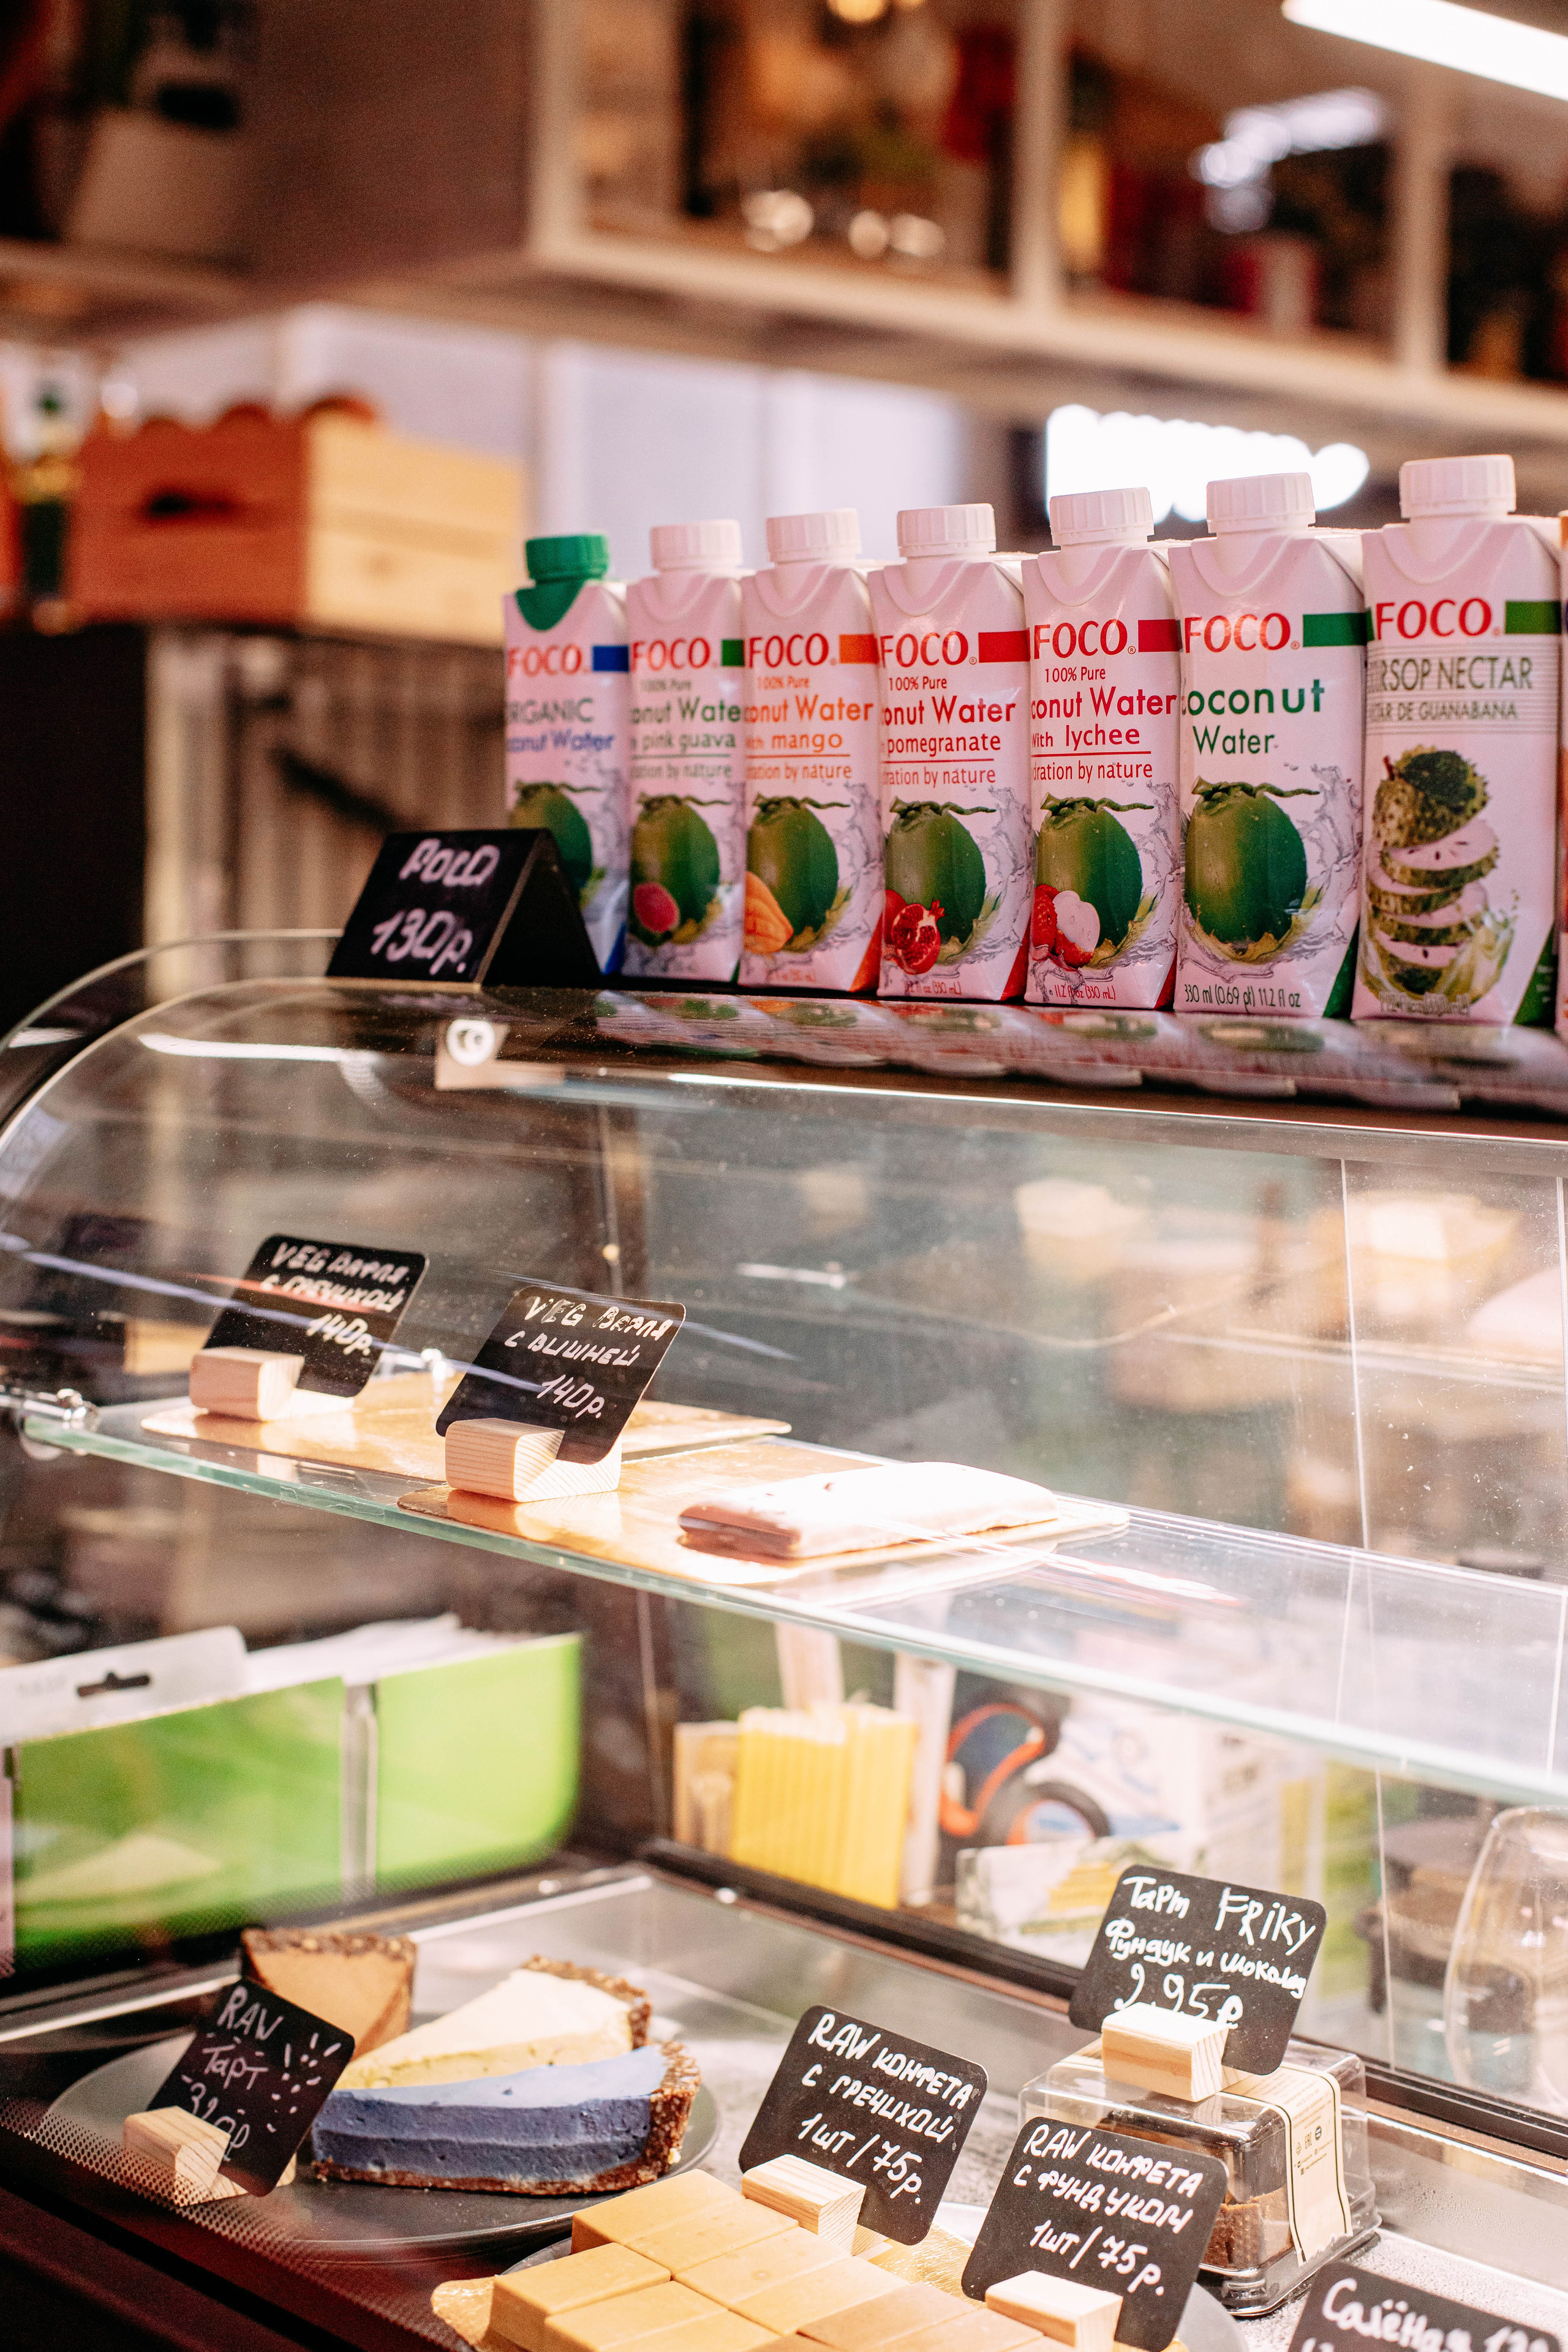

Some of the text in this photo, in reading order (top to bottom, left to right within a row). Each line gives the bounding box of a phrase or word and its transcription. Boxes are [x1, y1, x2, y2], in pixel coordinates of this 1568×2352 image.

[1184, 612, 1291, 654] FOCO
[1376, 597, 1493, 640] FOCO
[631, 637, 710, 672] FOCO
[749, 633, 829, 668] FOCO
[880, 630, 969, 668] FOCO
[1033, 619, 1128, 660] FOCO
[507, 644, 582, 677] FOCO
[1045, 666, 1106, 683] 100% Pure
[1438, 656, 1532, 690] NECTAR
[889, 676, 948, 691] 100% Pure
[1182, 679, 1325, 715] oconut
[678, 695, 741, 723] Wate
[795, 694, 873, 722] Water
[883, 695, 1016, 726] onut Water
[1090, 685, 1177, 717] Water
[1397, 702, 1414, 721] DE
[1419, 701, 1519, 721] GUANABANA
[772, 733, 843, 753] mango
[888, 734, 1001, 758] pomegranate
[1066, 723, 1140, 752] lychee
[1193, 725, 1275, 755] Water
[801, 765, 852, 780] nature
[924, 766, 938, 788] by
[943, 768, 996, 785] nature
[1078, 760, 1093, 784] by
[1098, 763, 1153, 779] nature
[1085, 984, 1101, 1000] (330
[1184, 984, 1199, 1003] 330
[1202, 986, 1213, 1004] ml
[1215, 984, 1239, 1006] (0.69
[1278, 988, 1285, 1007] fl
[1289, 992, 1301, 1008] oz
[271, 1242, 331, 1273] VEG
[524, 1296, 587, 1327] VEG
[216, 1985, 285, 2041] RAW
[807, 2013, 881, 2060] RAW
[1023, 2124, 1093, 2160] RAW
